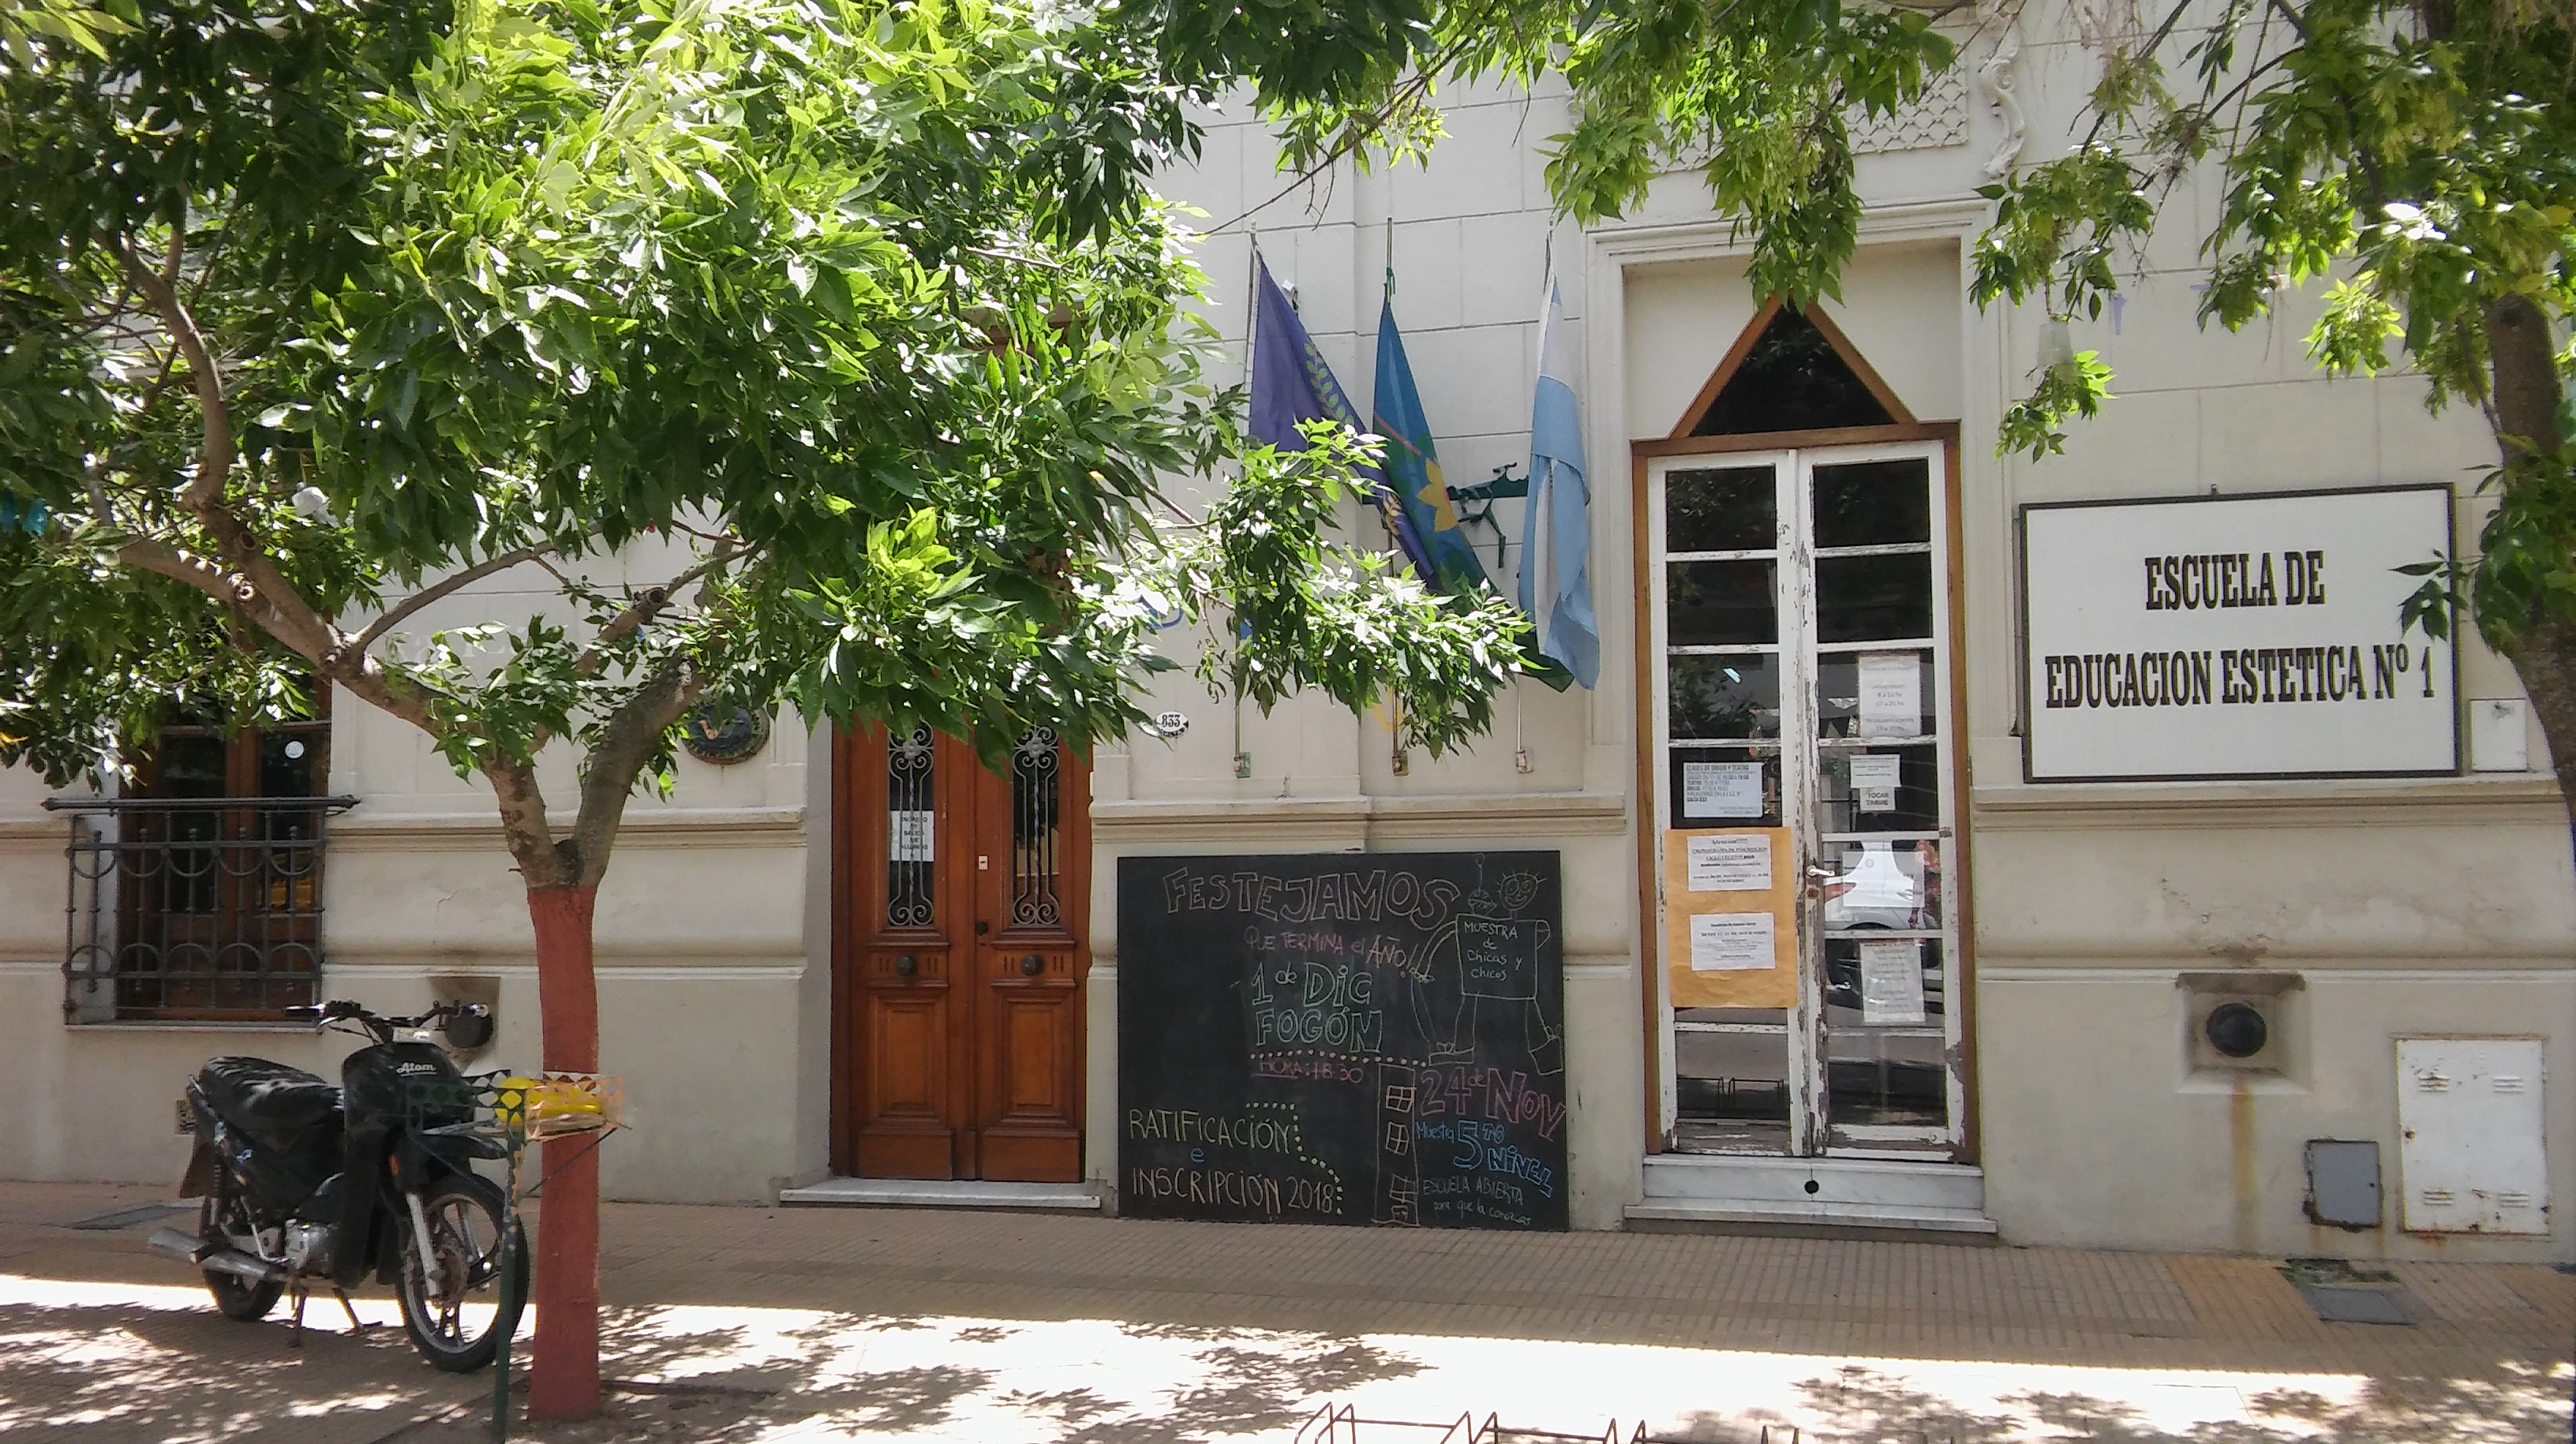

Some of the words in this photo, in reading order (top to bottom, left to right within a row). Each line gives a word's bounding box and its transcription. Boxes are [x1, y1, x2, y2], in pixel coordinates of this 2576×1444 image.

[2145, 552, 2277, 610] ESCUELA
[2285, 551, 2326, 605] DE
[2045, 650, 2211, 709] EDUCACION
[2221, 645, 2367, 704] ESTETICA
[2421, 645, 2435, 698] 1
[1162, 714, 1181, 728] 833
[1163, 867, 1460, 930] FESTEJAMOS
[1464, 921, 1518, 939] MUESTRA
[1281, 932, 1343, 955] TERMINA
[1483, 937, 1497, 950] de
[1515, 957, 1522, 971] y
[1250, 962, 1274, 1005] 1
[1275, 962, 1297, 984] de
[1256, 1006, 1382, 1053] FOGÓN
[396, 1062, 436, 1073] Atom
[1421, 1067, 1472, 1117] 24
[1468, 1068, 1487, 1087] de
[1417, 1121, 1455, 1143] Muestra
[1191, 1148, 1204, 1162] e
[1286, 1177, 1334, 1214] 2018
[1424, 1175, 1470, 1195] ESCUELA
[1477, 1176, 1523, 1206] ABIERTA
[1458, 1200, 1473, 1219] que
[1477, 1199, 1486, 1215] la
